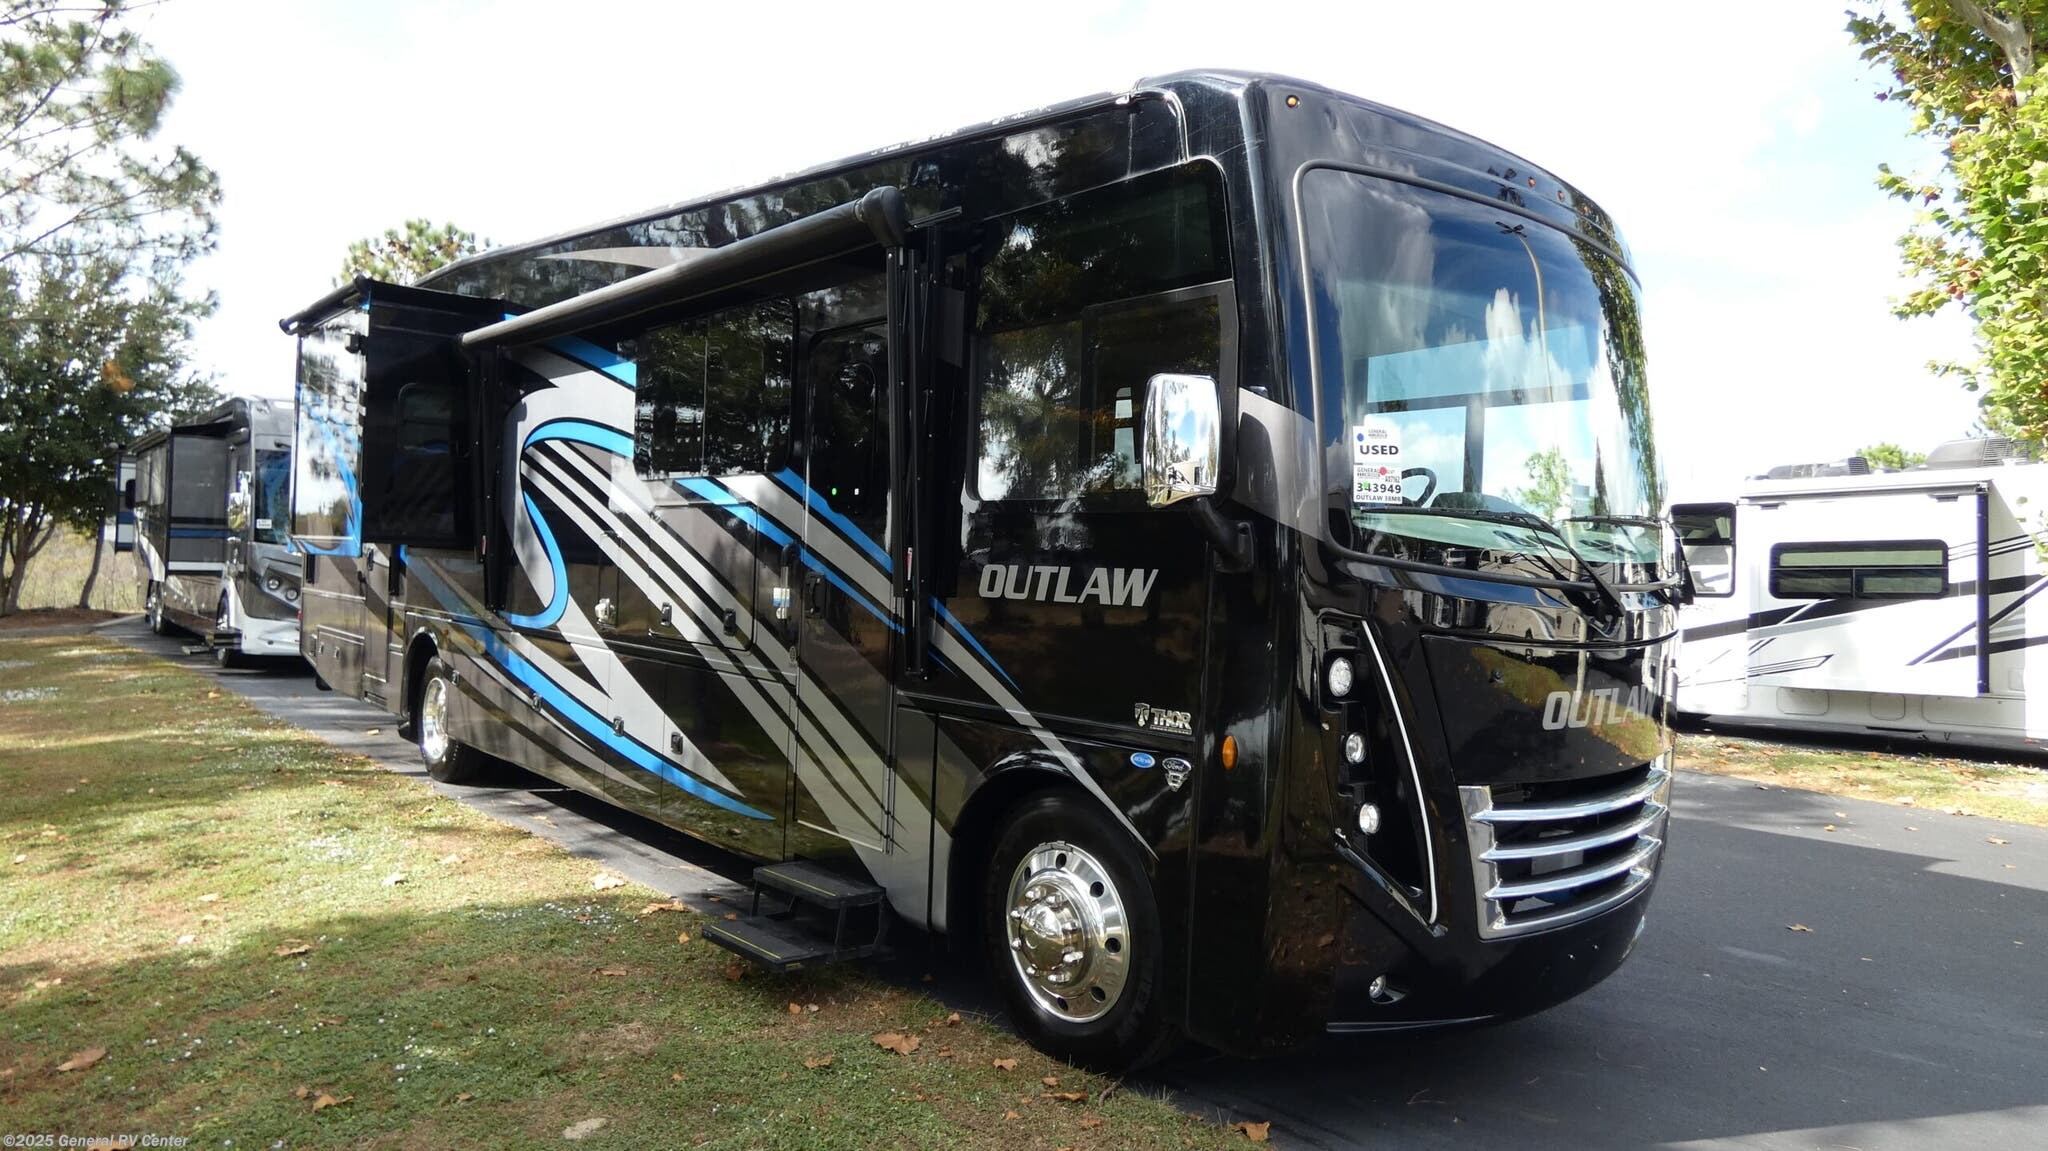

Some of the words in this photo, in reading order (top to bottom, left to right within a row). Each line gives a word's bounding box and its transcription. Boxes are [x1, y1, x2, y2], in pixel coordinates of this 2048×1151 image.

[1360, 445, 1399, 455] USED
[1357, 482, 1402, 494] 343949
[978, 563, 1159, 607] OUTLAW
[1151, 707, 1192, 730] THOR
[1542, 684, 1659, 731] OUTLAW
